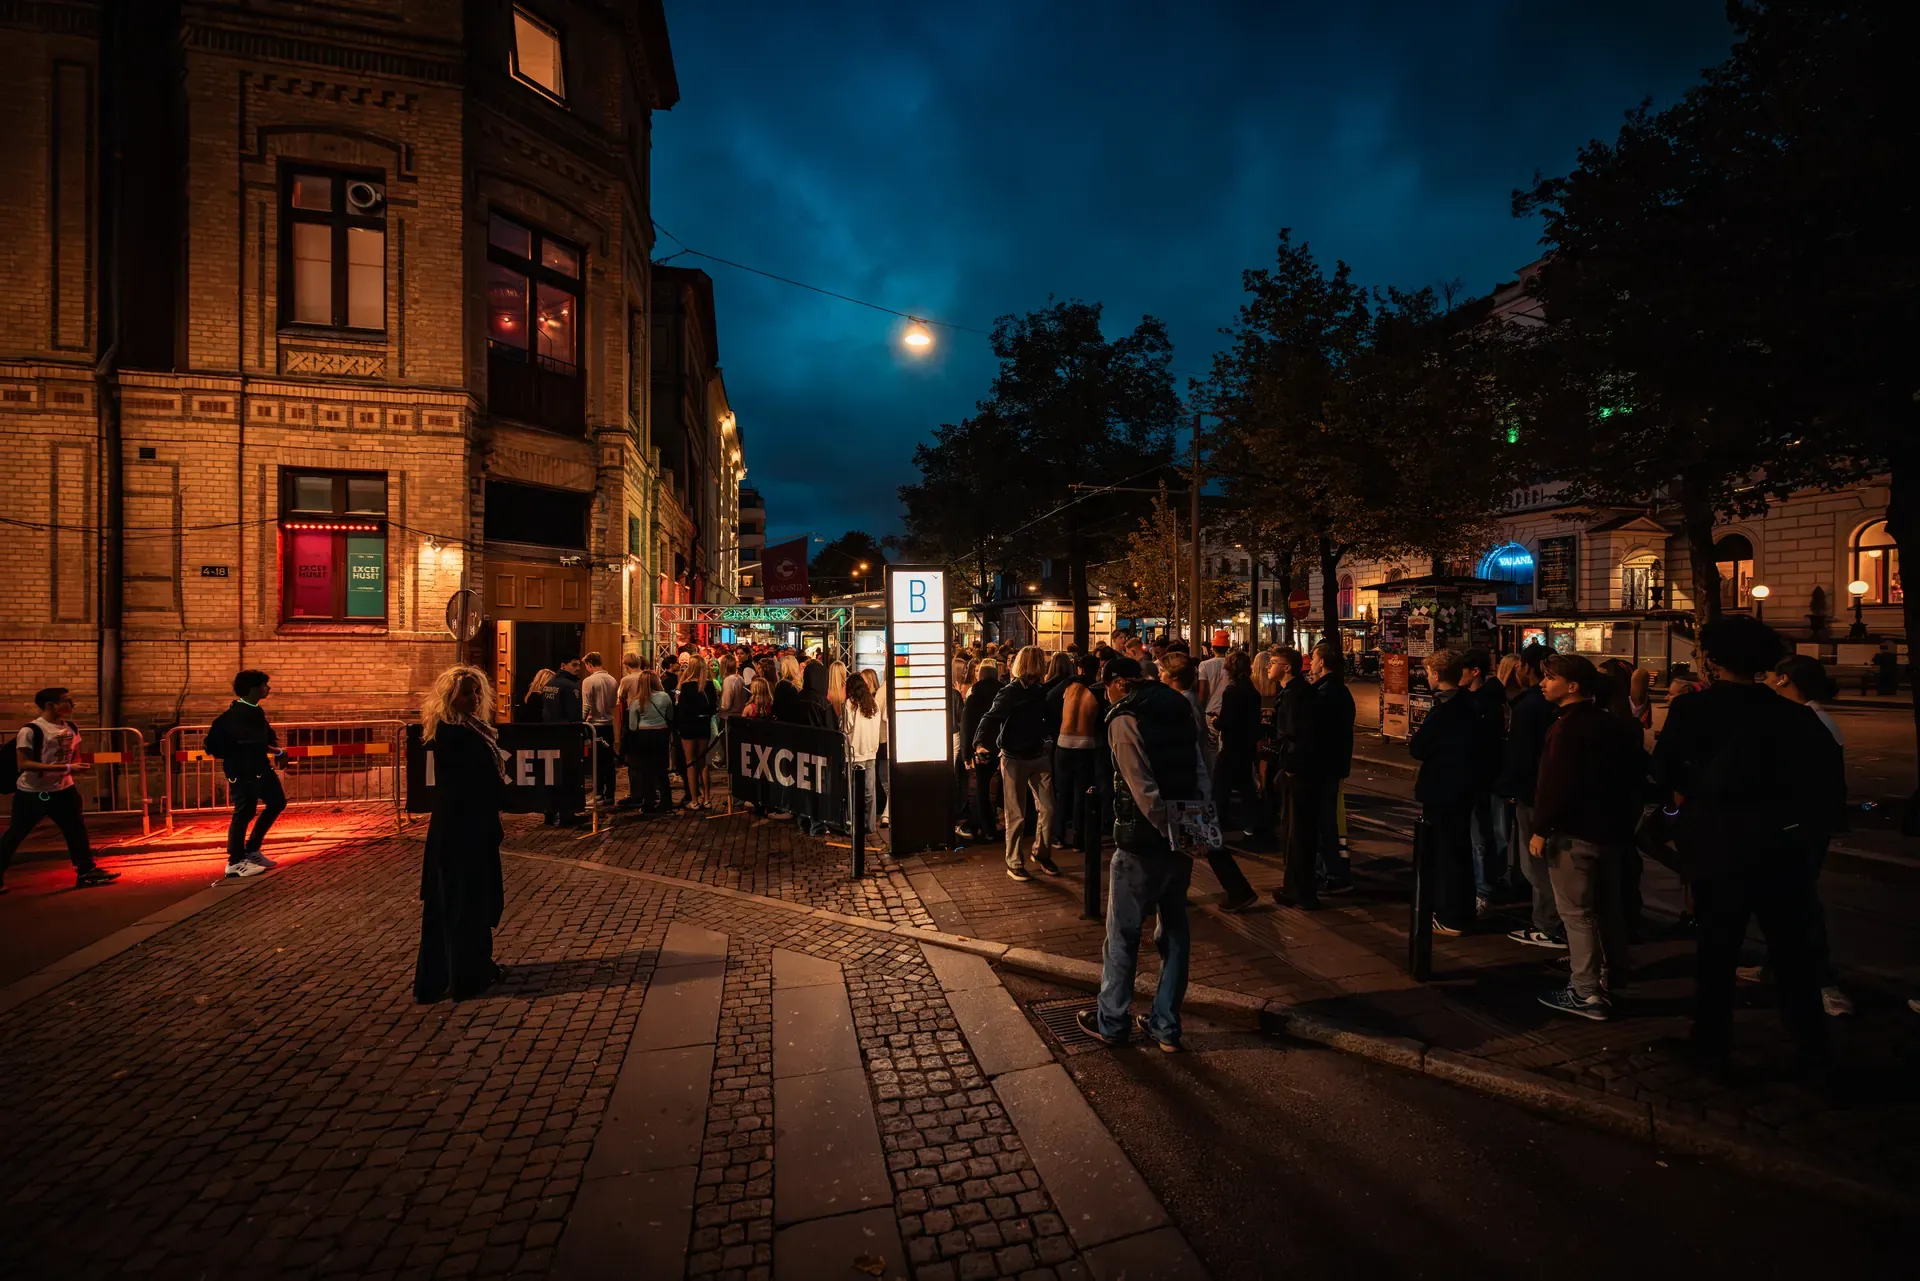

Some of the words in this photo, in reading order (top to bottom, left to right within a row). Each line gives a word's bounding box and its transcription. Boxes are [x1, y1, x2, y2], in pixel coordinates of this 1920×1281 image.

[202, 567, 226, 576] 4-18
[352, 572, 380, 580] HUSET
[909, 579, 927, 613] B
[741, 742, 827, 794] EXCET
